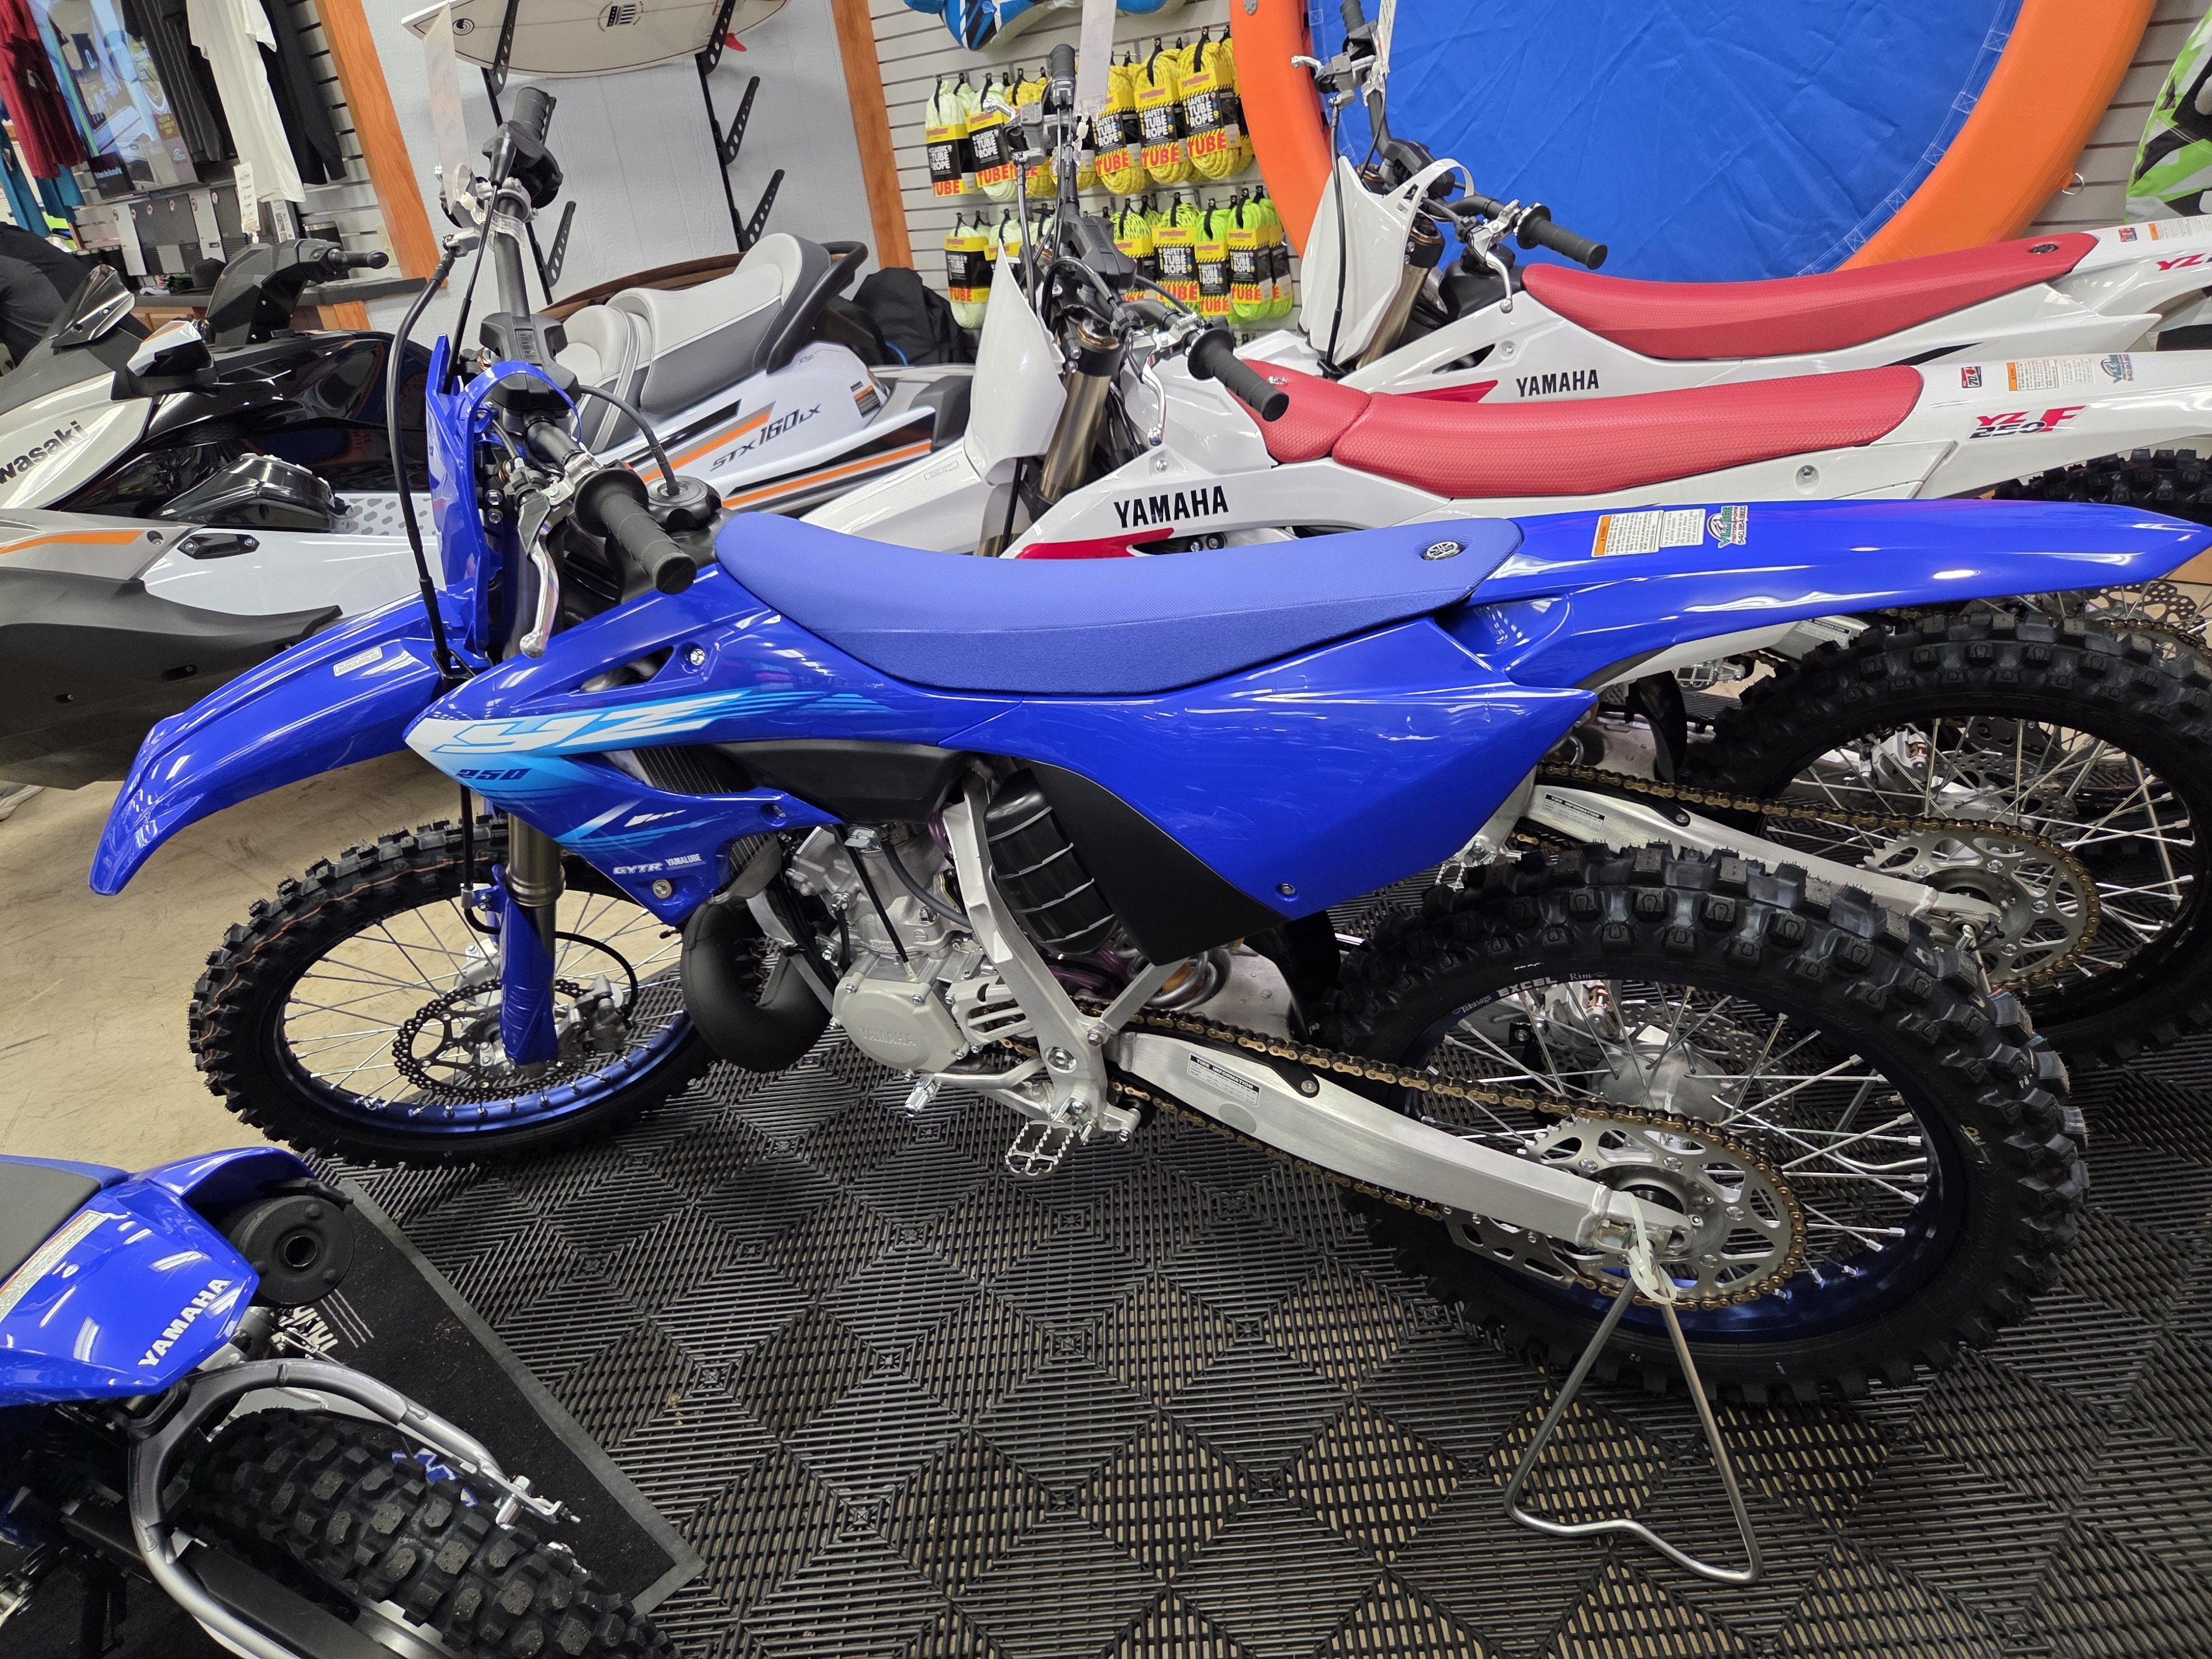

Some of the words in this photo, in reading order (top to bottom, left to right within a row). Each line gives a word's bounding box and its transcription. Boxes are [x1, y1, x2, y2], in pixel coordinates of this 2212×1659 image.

[1187, 93, 1210, 107] SAFETY
[1143, 107, 1165, 118] SAFETY
[1188, 102, 1212, 115] TUBE
[1096, 115, 1114, 128] SAFETY
[1144, 114, 1167, 129] TUBE
[1190, 112, 1214, 128] ROPE
[976, 131, 995, 140] CLASSIC
[1097, 122, 1117, 137] TUBE
[1146, 124, 1168, 139] ROPE
[977, 137, 997, 149] TUBE
[1098, 133, 1119, 147] ROPE
[1187, 132, 1227, 158] TUBE
[931, 151, 949, 162] TUBE
[978, 145, 998, 159] ROPE
[1142, 145, 1180, 169] TUBE
[933, 160, 951, 171] ROPE
[1095, 152, 1129, 176] TUBE
[978, 164, 1010, 185] TUBE
[1163, 247, 1185, 256] SAFETY
[1164, 255, 1186, 265] TUBE
[1234, 258, 1250, 266] TUBE
[2156, 253, 2206, 271] YZ
[1164, 264, 1187, 274] ROPE
[1202, 269, 1218, 278] TUBE
[1234, 264, 1251, 273] ROPE
[1202, 276, 1219, 285] ROPE
[950, 287, 972, 302] TUBE
[1232, 286, 1261, 301] TUBE
[1200, 299, 1229, 313] TUBE
[1516, 369, 1599, 397] YAMAHA
[1113, 486, 1229, 529] YAMAHA
[455, 768, 532, 781] 250
[1564, 801, 1600, 818] INFORMATION
[613, 862, 663, 874] GYTR
[665, 853, 702, 867] YAMALUBE
[1496, 977, 1558, 997] EXCEL
[857, 1026, 917, 1046] YAMAHA
[1196, 1058, 1211, 1068] TIRE
[1212, 1066, 1254, 1089] INFORMATION
[138, 1279, 231, 1366] YAMAHA
